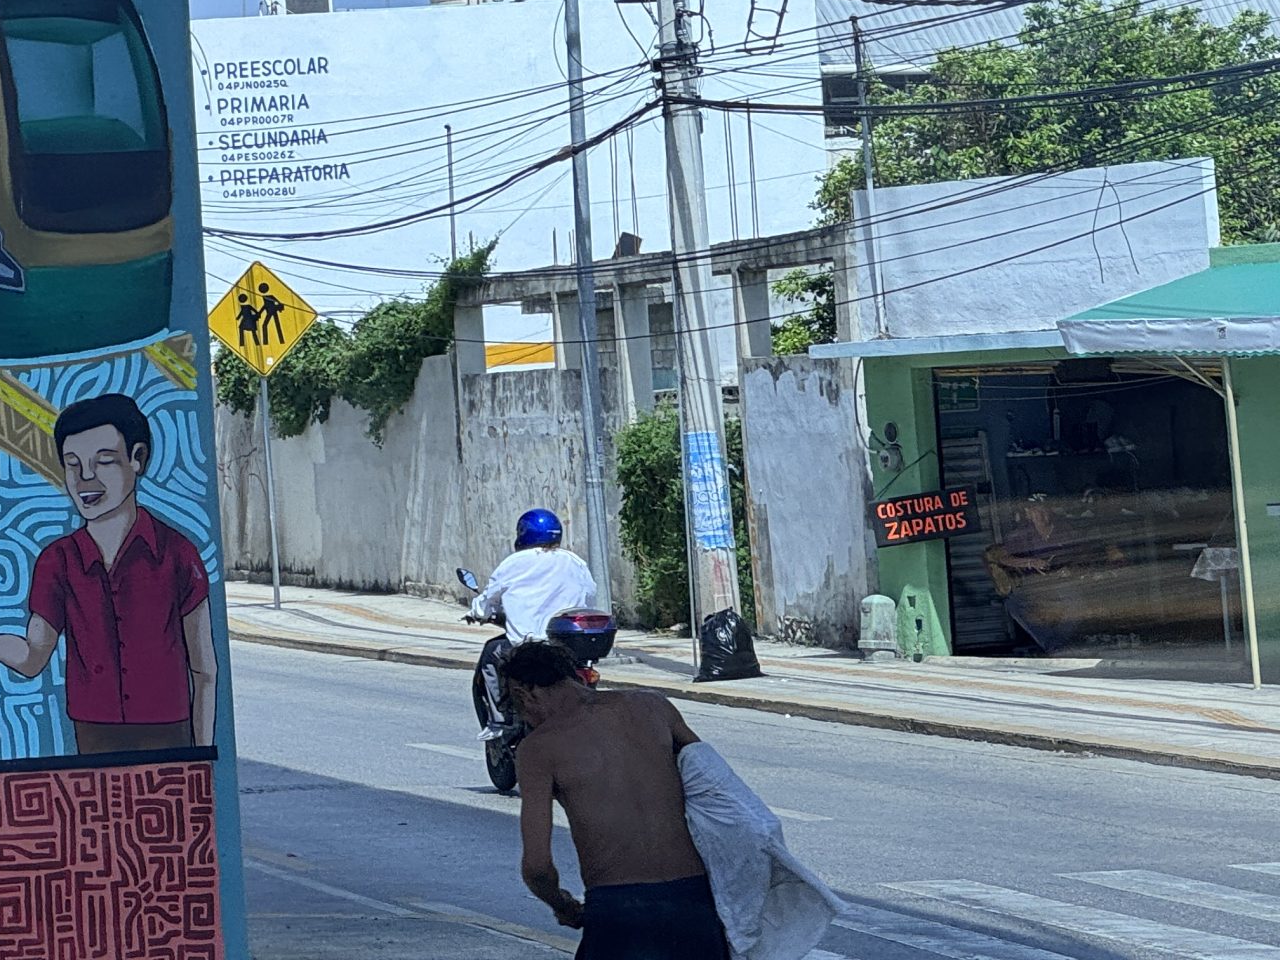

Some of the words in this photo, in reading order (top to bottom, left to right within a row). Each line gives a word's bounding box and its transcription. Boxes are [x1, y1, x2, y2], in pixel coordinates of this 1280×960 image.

[214, 56, 329, 80] PREESCOLAR
[217, 93, 310, 115] PRIMARIA
[220, 114, 294, 127] 04PPR0007R
[218, 128, 329, 150] SECUNDARIA
[221, 150, 296, 163] 04PES0026Z
[220, 163, 351, 186] PREPARATORIA
[876, 495, 944, 519] COSTURA
[950, 491, 969, 507] DE
[884, 511, 967, 540] ZAPATOS
